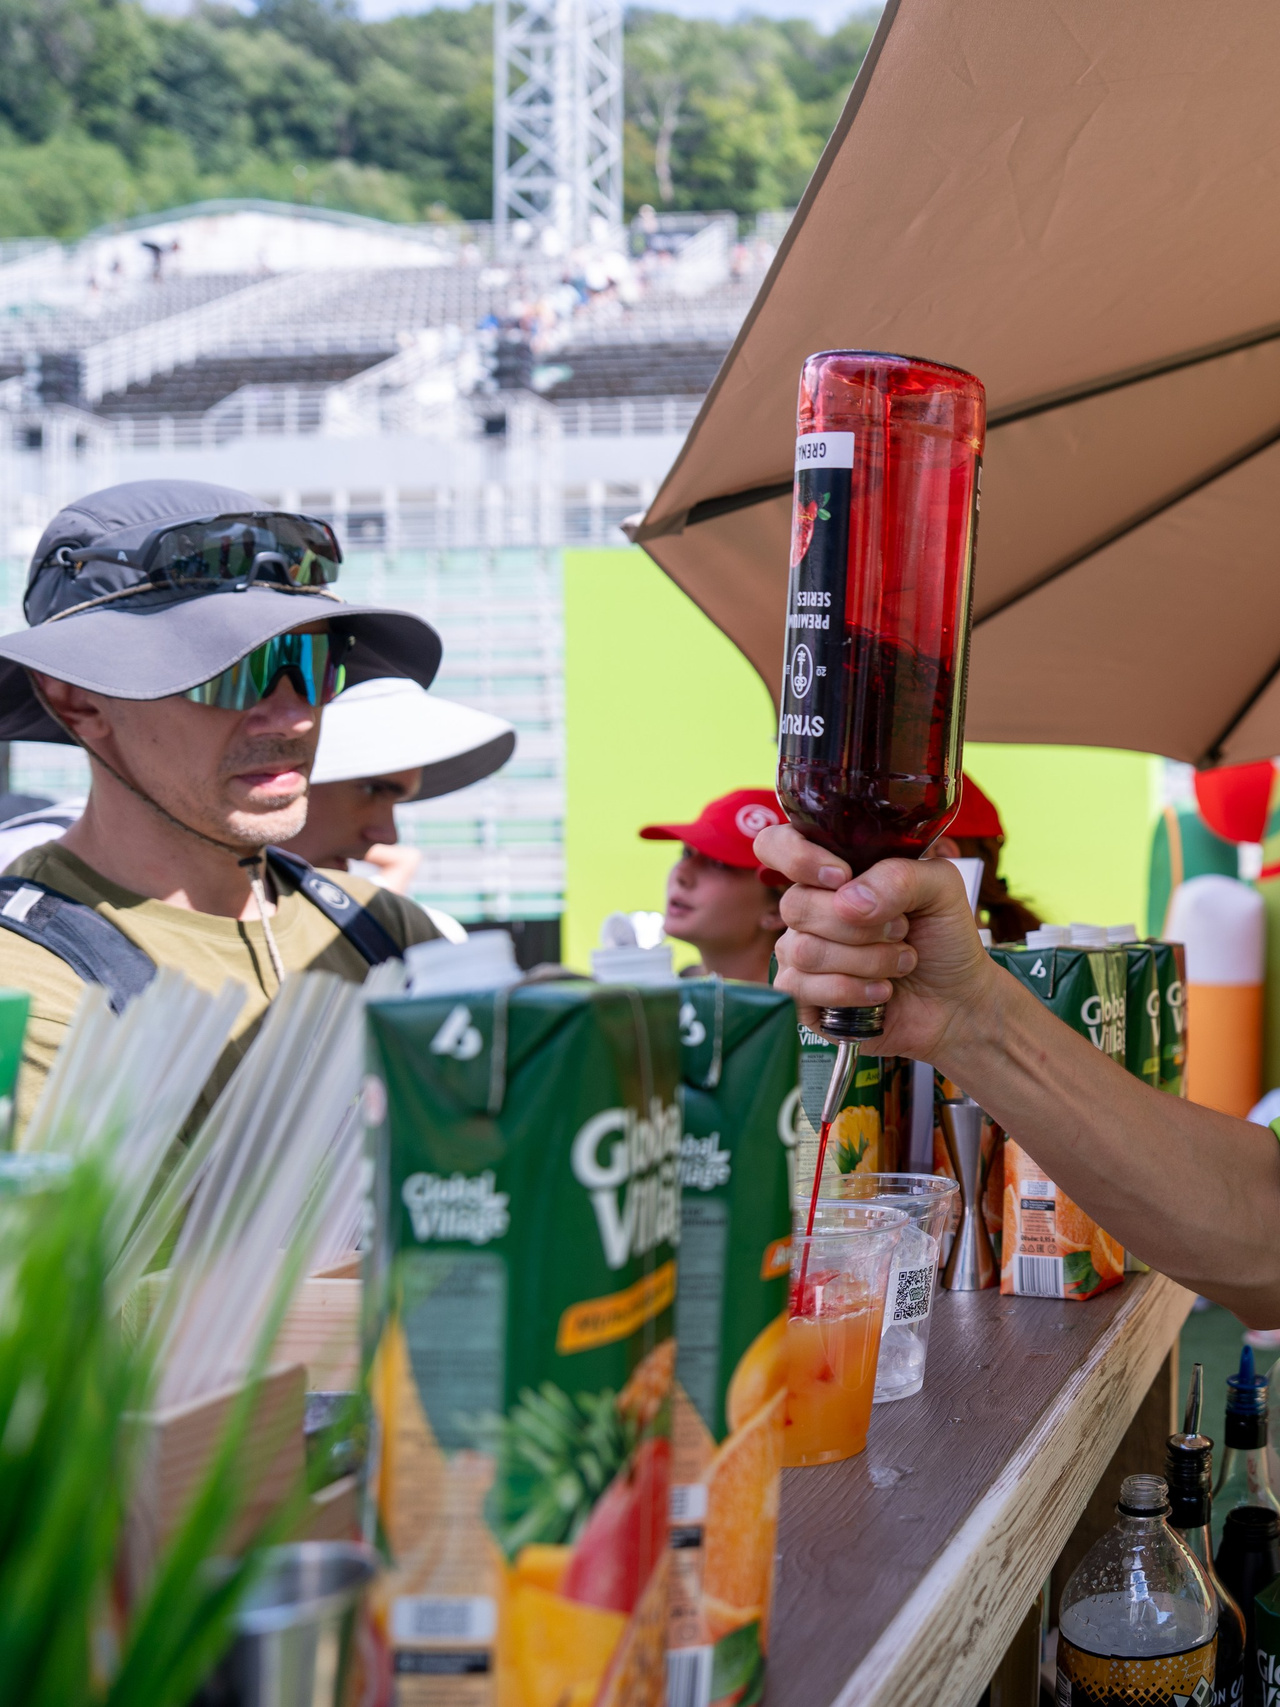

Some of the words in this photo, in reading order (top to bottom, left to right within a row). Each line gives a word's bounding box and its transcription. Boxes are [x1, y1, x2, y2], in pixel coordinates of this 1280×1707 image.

[798, 442, 828, 460] GRENA
[797, 591, 832, 607] SERIES
[799, 1032, 830, 1047] Villag
